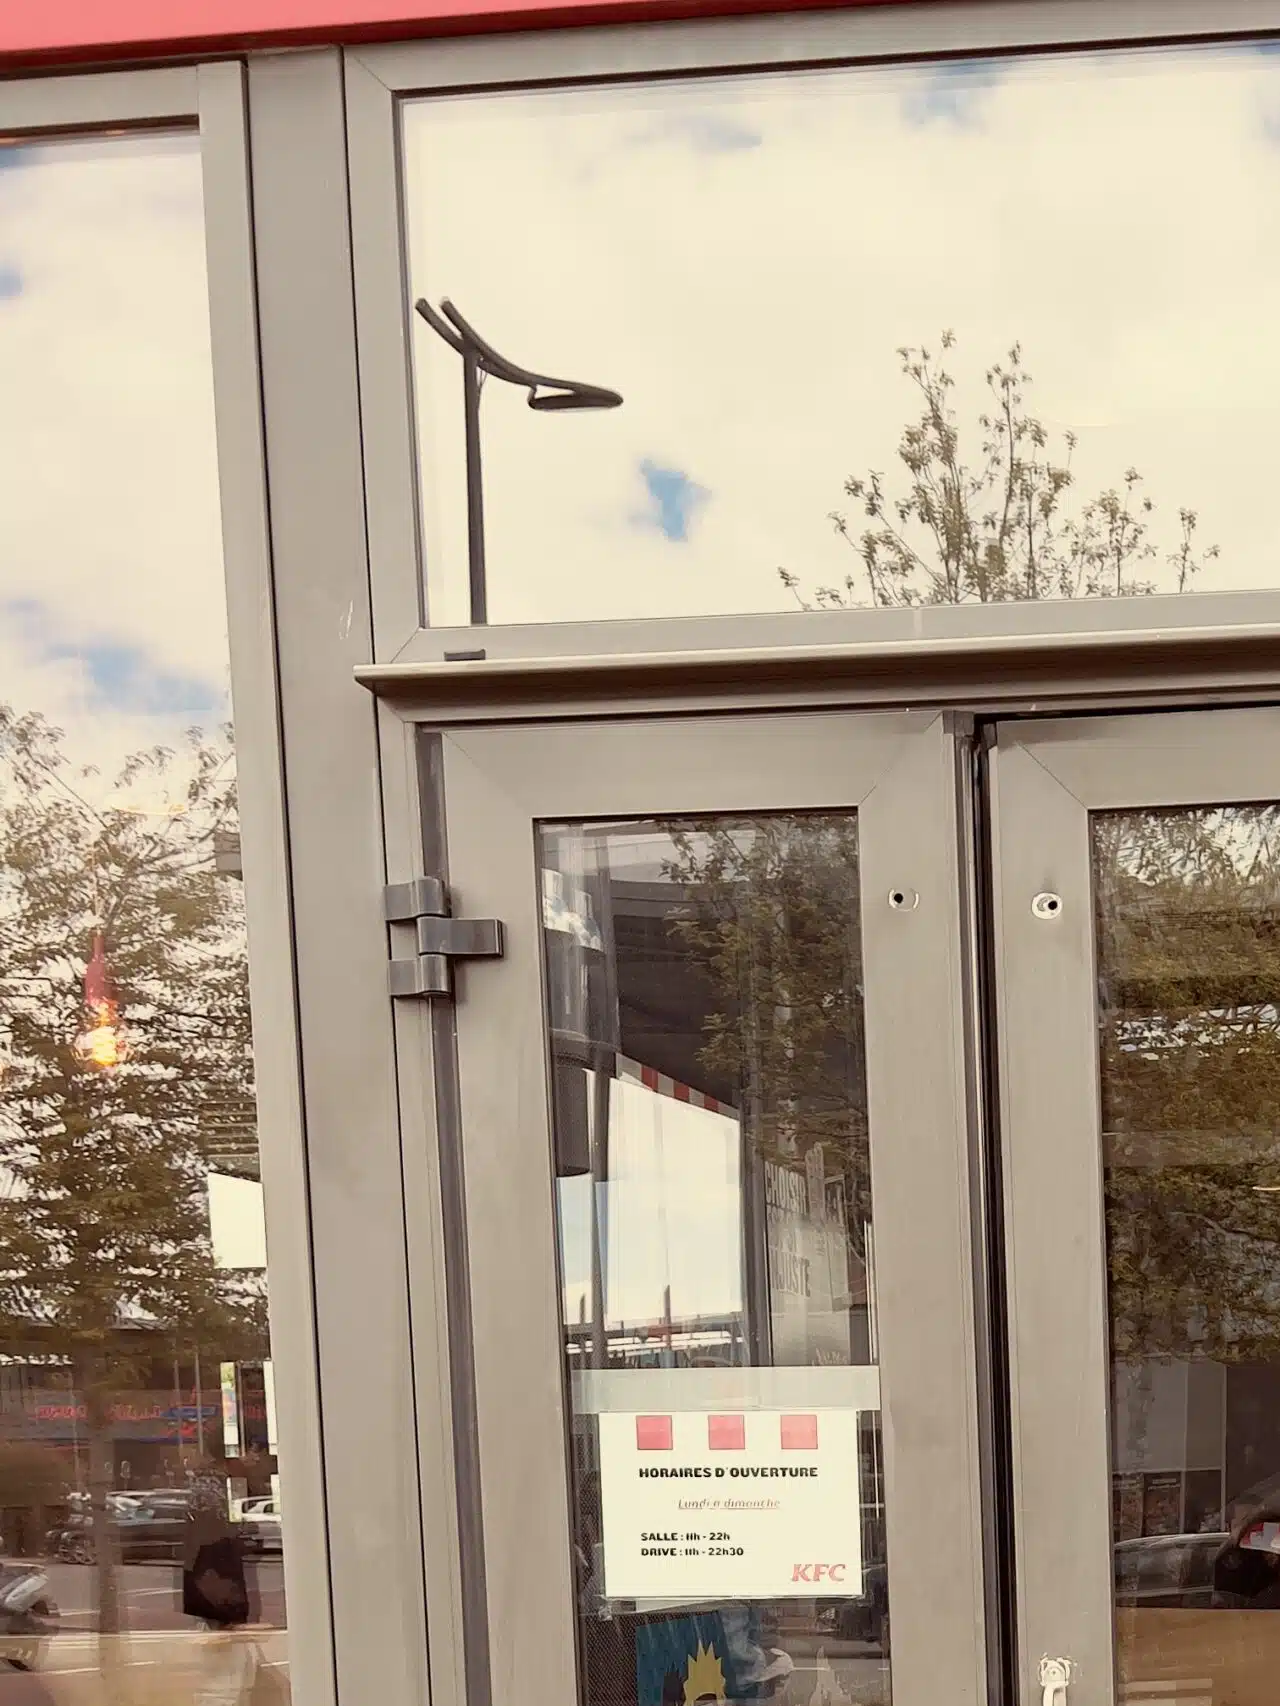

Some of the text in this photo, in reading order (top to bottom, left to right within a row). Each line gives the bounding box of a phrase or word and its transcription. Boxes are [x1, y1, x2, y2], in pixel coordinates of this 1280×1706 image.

[638, 1467, 818, 1478] HORAIRES D'OUVERTURE
[678, 1497, 710, 1509] Lundi
[724, 1497, 780, 1509] dimanche
[640, 1532, 679, 1542] SALLE
[709, 1532, 731, 1542] 22h
[640, 1547, 678, 1557] DRIVE
[708, 1547, 745, 1557] 22h30
[791, 1563, 846, 1582] KFC
